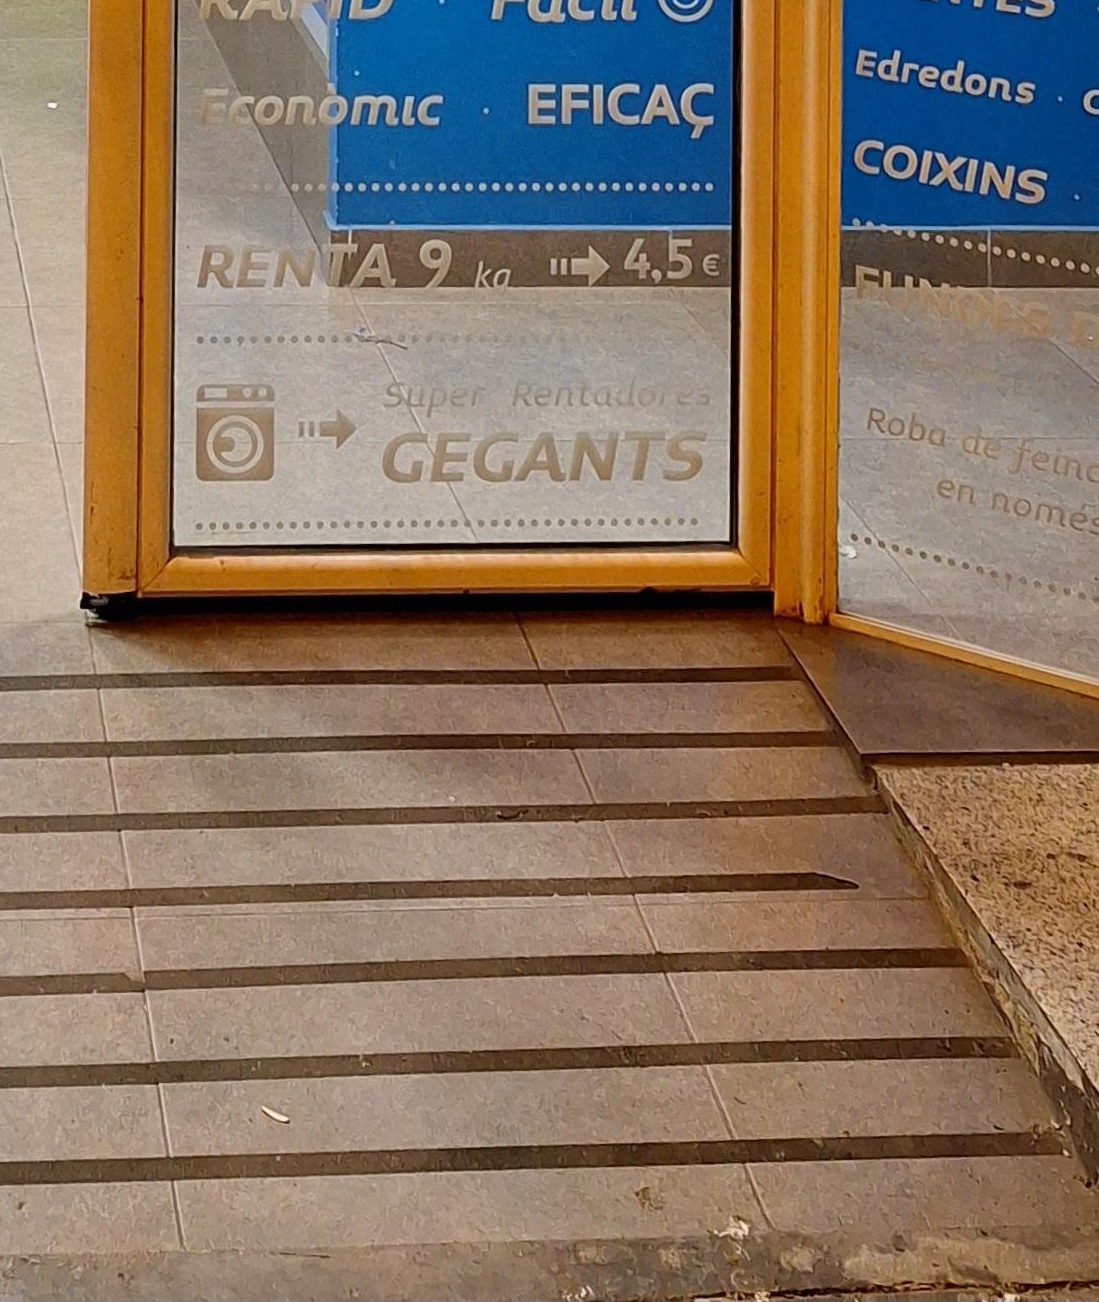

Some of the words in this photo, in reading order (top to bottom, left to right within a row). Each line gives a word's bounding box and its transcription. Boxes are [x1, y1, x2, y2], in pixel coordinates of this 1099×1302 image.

[855, 48, 1036, 105] Edredons
[526, 83, 715, 138] EFICAÇ
[853, 139, 1049, 205] COIXINS
[196, 240, 397, 289] RENTA
[418, 239, 453, 289] 9
[381, 429, 708, 484] GEGANTS
[866, 407, 948, 447] Roba
[961, 426, 1000, 461] de
[936, 477, 976, 507] en
